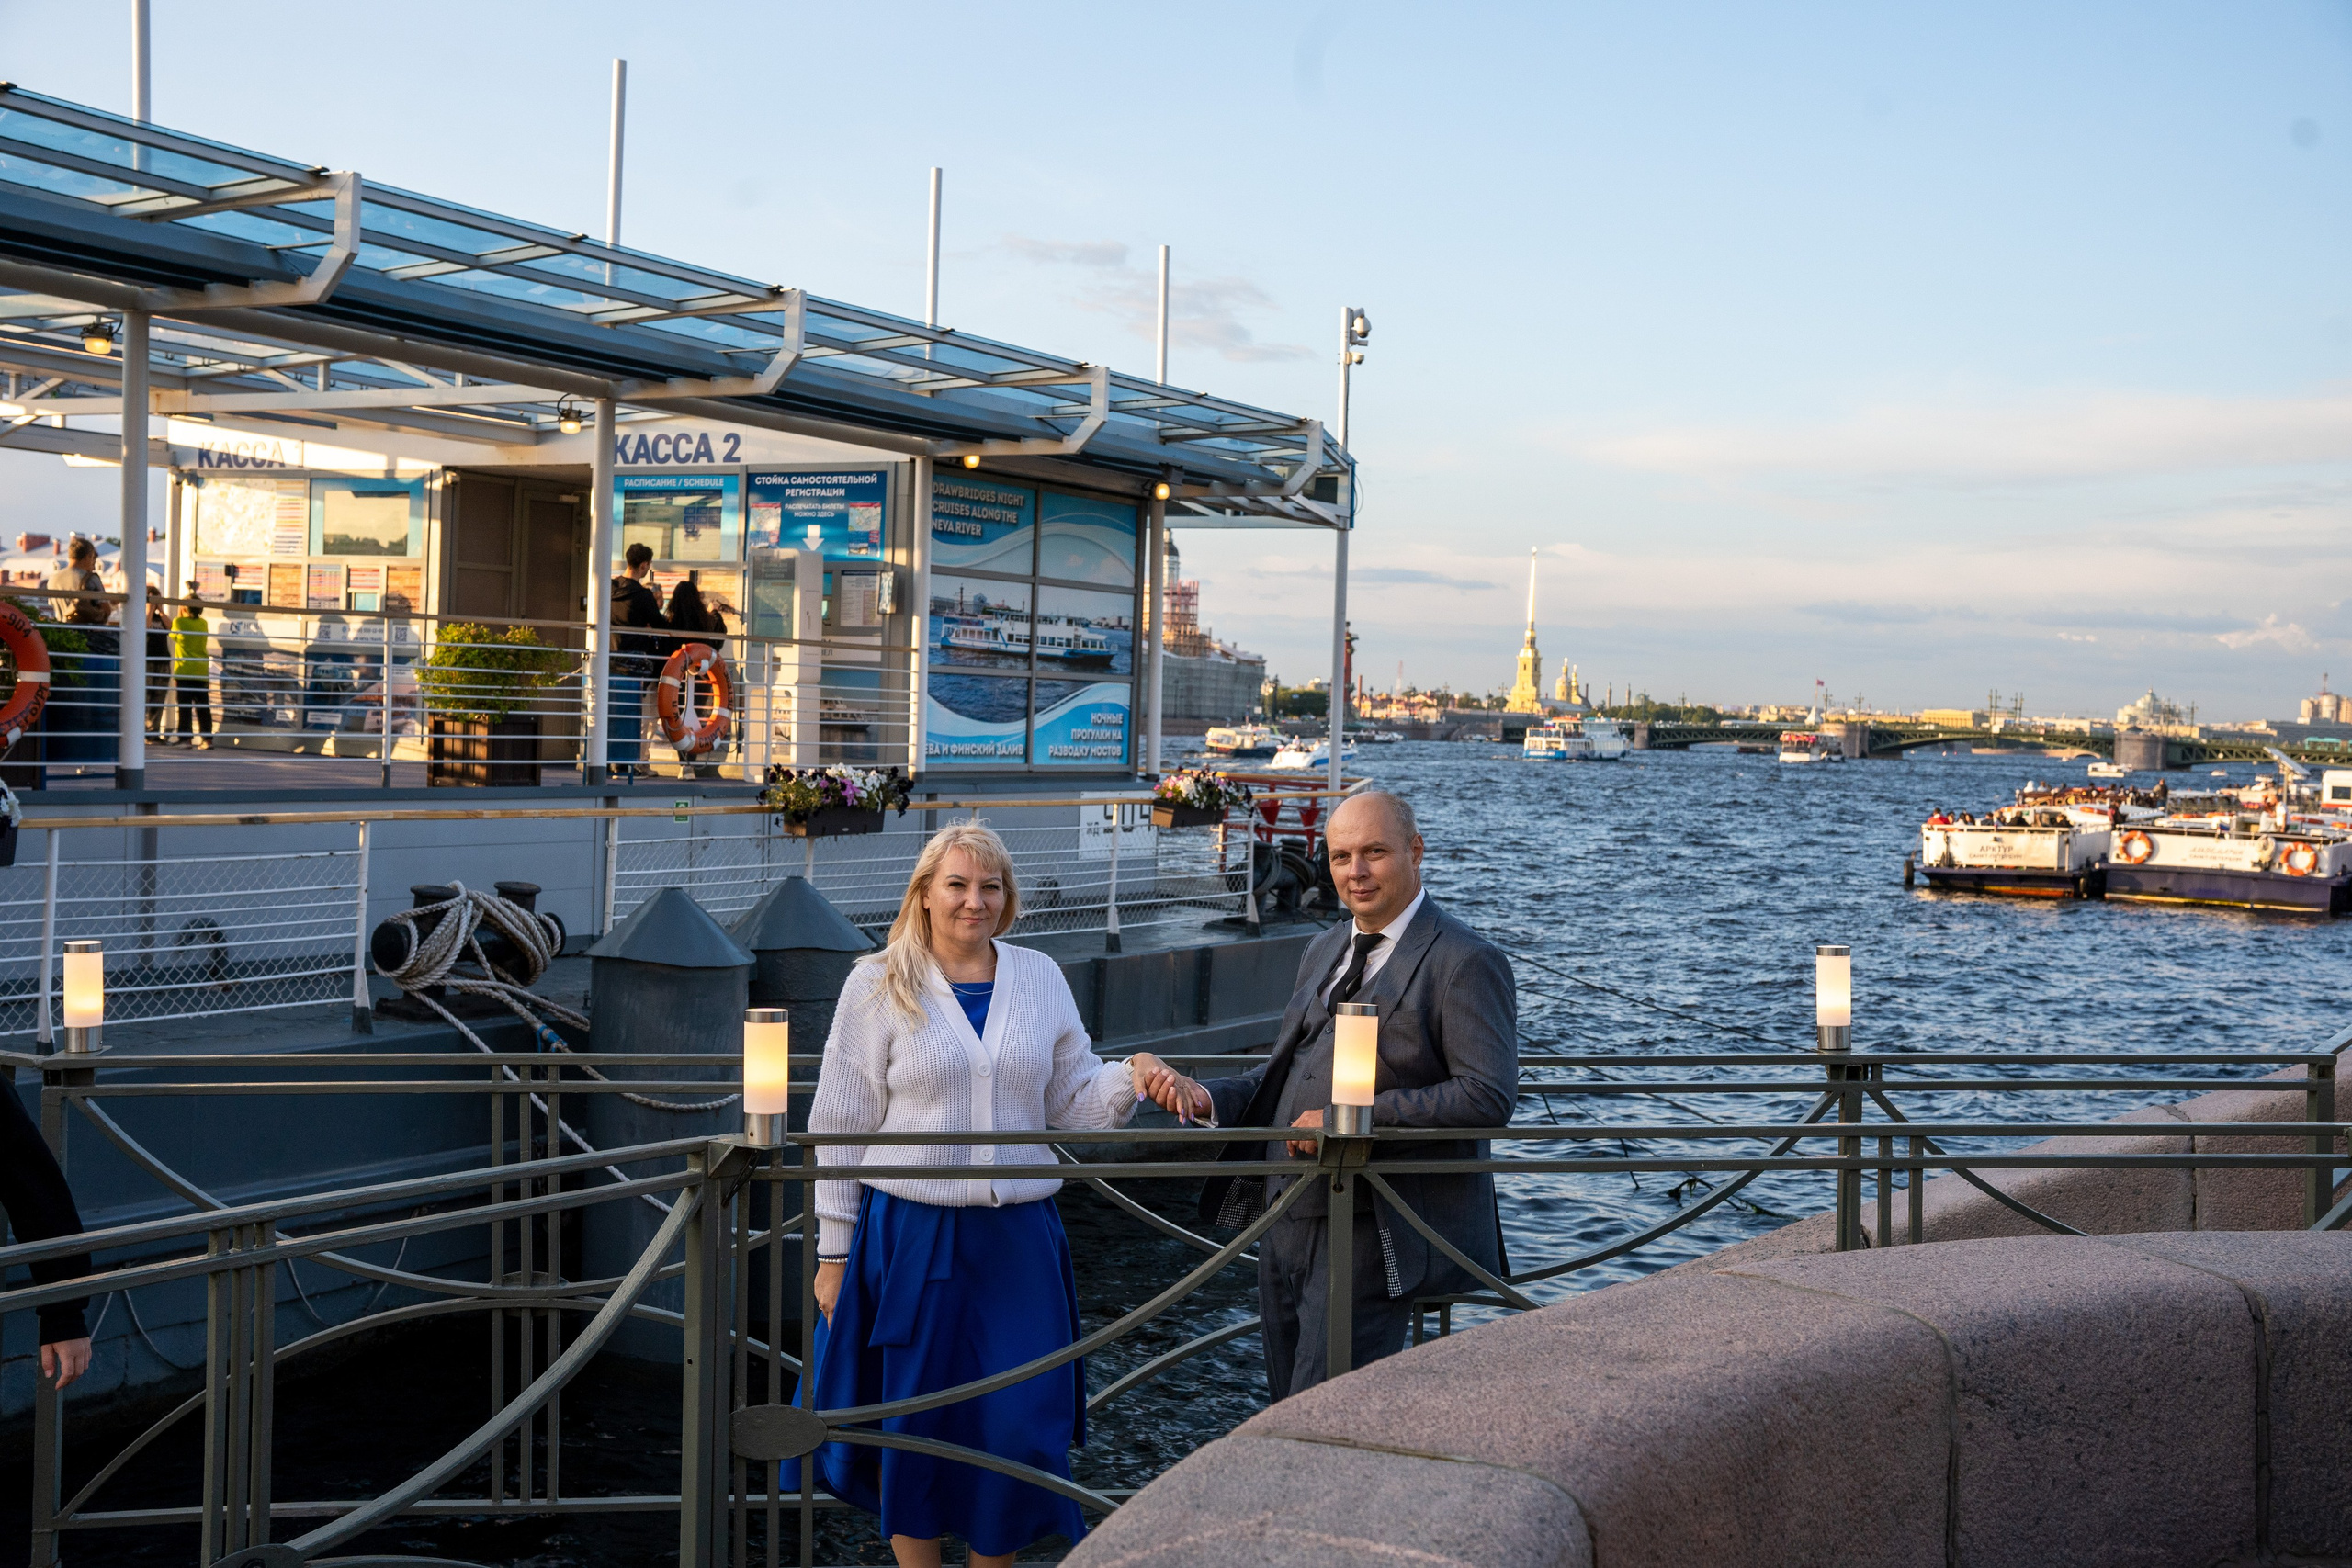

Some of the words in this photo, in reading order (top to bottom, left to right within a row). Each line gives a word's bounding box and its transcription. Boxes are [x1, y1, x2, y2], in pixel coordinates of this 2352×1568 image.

[198, 440, 286, 468] КАССА
[614, 432, 715, 465] КАССА
[722, 433, 741, 464] 2
[624, 478, 677, 488] РАСПИСАНИЕ
[684, 478, 725, 487] SCHEDULE
[755, 475, 790, 485] СТОЙКА
[791, 473, 877, 485] САМОСТОЯТЕЛЬНОЙ
[785, 488, 845, 497] РЕГИСТРАЦИИ
[933, 481, 996, 503] DRAWBRIDGES
[998, 494, 1024, 507] NIGHT
[933, 501, 970, 516] CRUISES
[971, 507, 1001, 522] ALONG
[1002, 511, 1017, 524] THE
[932, 518, 955, 534] NEVA
[956, 522, 982, 536] RIVER
[1091, 713, 1123, 724] НОЧНЫЕ
[1071, 728, 1110, 740] ПРОГУЛКИ
[1111, 728, 1123, 740] НА
[925, 743, 940, 756] ЕВА
[943, 743, 948, 755] И
[951, 741, 995, 756] ФИНСКИЙ
[996, 743, 1023, 756] ЗАЛИВ
[1049, 745, 1089, 757] РАЗВОДКУ
[1091, 745, 1122, 757] МОСТОВ
